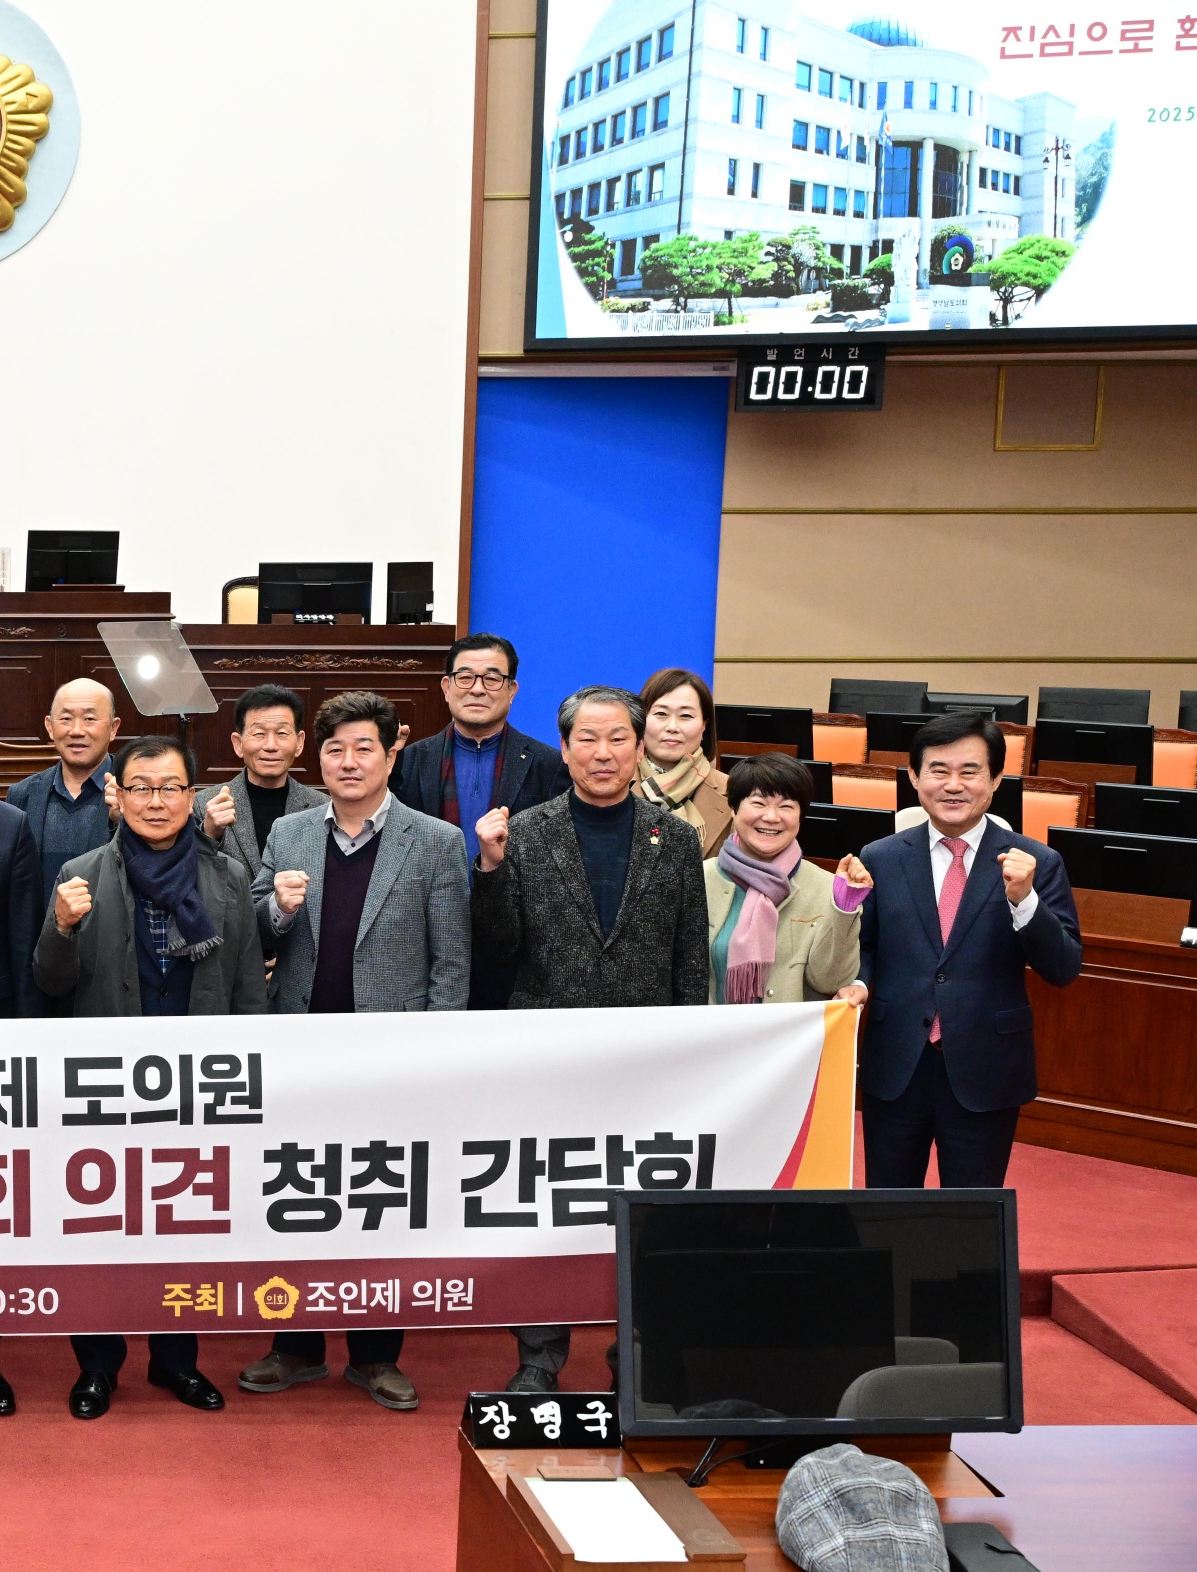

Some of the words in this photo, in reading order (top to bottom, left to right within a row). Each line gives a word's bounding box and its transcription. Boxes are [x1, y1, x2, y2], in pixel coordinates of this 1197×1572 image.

[999, 19, 1155, 60] 진심으로
[62, 1052, 264, 1126] 도의원
[62, 1145, 231, 1236] 의견
[261, 1140, 430, 1233] 청취
[161, 1280, 224, 1317] 주최
[265, 1293, 287, 1306] 의회
[305, 1279, 400, 1315] 조인제
[411, 1277, 474, 1313] 의원
[478, 1400, 613, 1440] 장명국
